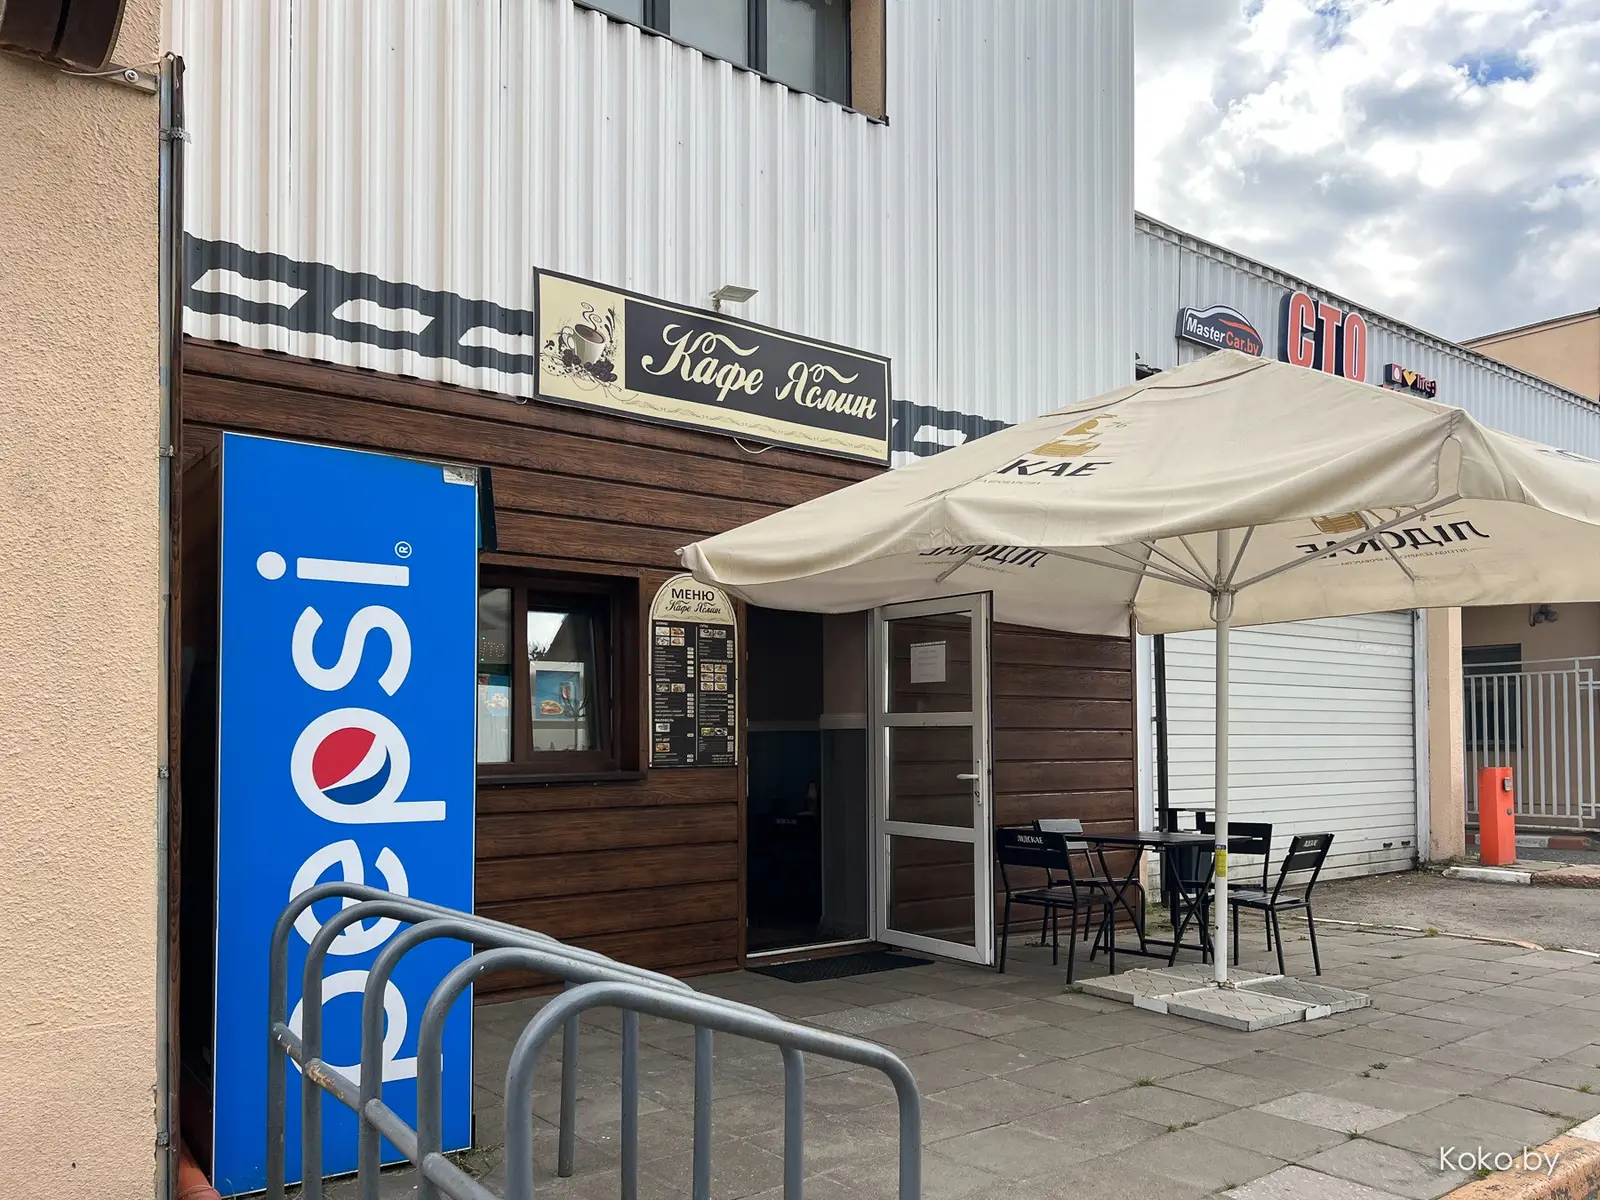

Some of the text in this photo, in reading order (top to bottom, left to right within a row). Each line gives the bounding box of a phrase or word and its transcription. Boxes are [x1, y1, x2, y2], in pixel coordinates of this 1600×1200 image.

[1186, 317, 1260, 356] MasterCar.by
[1287, 290, 1367, 383] СТО
[641, 323, 877, 420] Кафе Ясмин
[665, 599, 691, 614] Кафе
[671, 588, 715, 601] МЕНЮ
